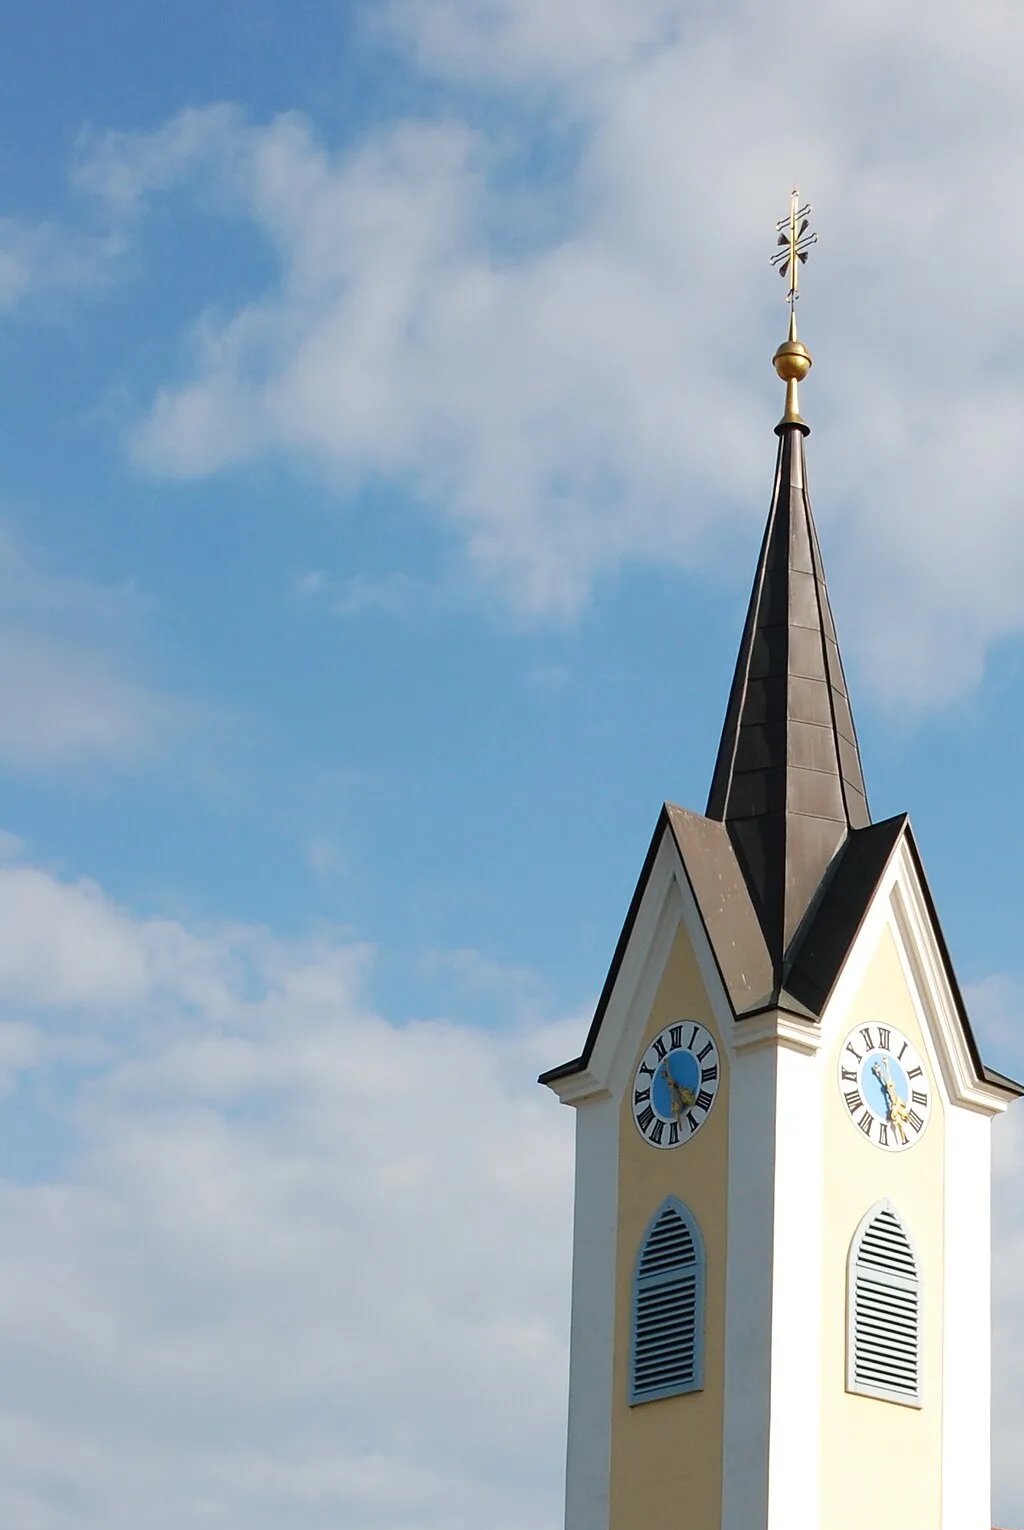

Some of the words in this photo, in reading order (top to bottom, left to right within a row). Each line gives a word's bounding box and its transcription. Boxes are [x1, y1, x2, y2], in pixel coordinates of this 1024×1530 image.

[652, 1036, 668, 1062] XI
[669, 1025, 683, 1051] XII
[688, 1026, 699, 1050] I
[860, 1027, 875, 1052] XI
[877, 1027, 891, 1051] XII
[696, 1041, 714, 1062] II
[846, 1041, 862, 1064] X
[897, 1041, 908, 1060] I
[640, 1061, 655, 1079] X
[701, 1064, 717, 1084] III
[842, 1066, 857, 1083] IX
[907, 1065, 923, 1079] II
[635, 1088, 650, 1105] IX
[844, 1088, 863, 1115] VIII
[912, 1090, 927, 1107] III
[637, 1104, 655, 1134] VIII
[686, 1110, 699, 1133] V
[858, 1110, 874, 1137] VII
[649, 1121, 665, 1144] VII
[668, 1122, 679, 1145] VI
[879, 1123, 889, 1146] VI
